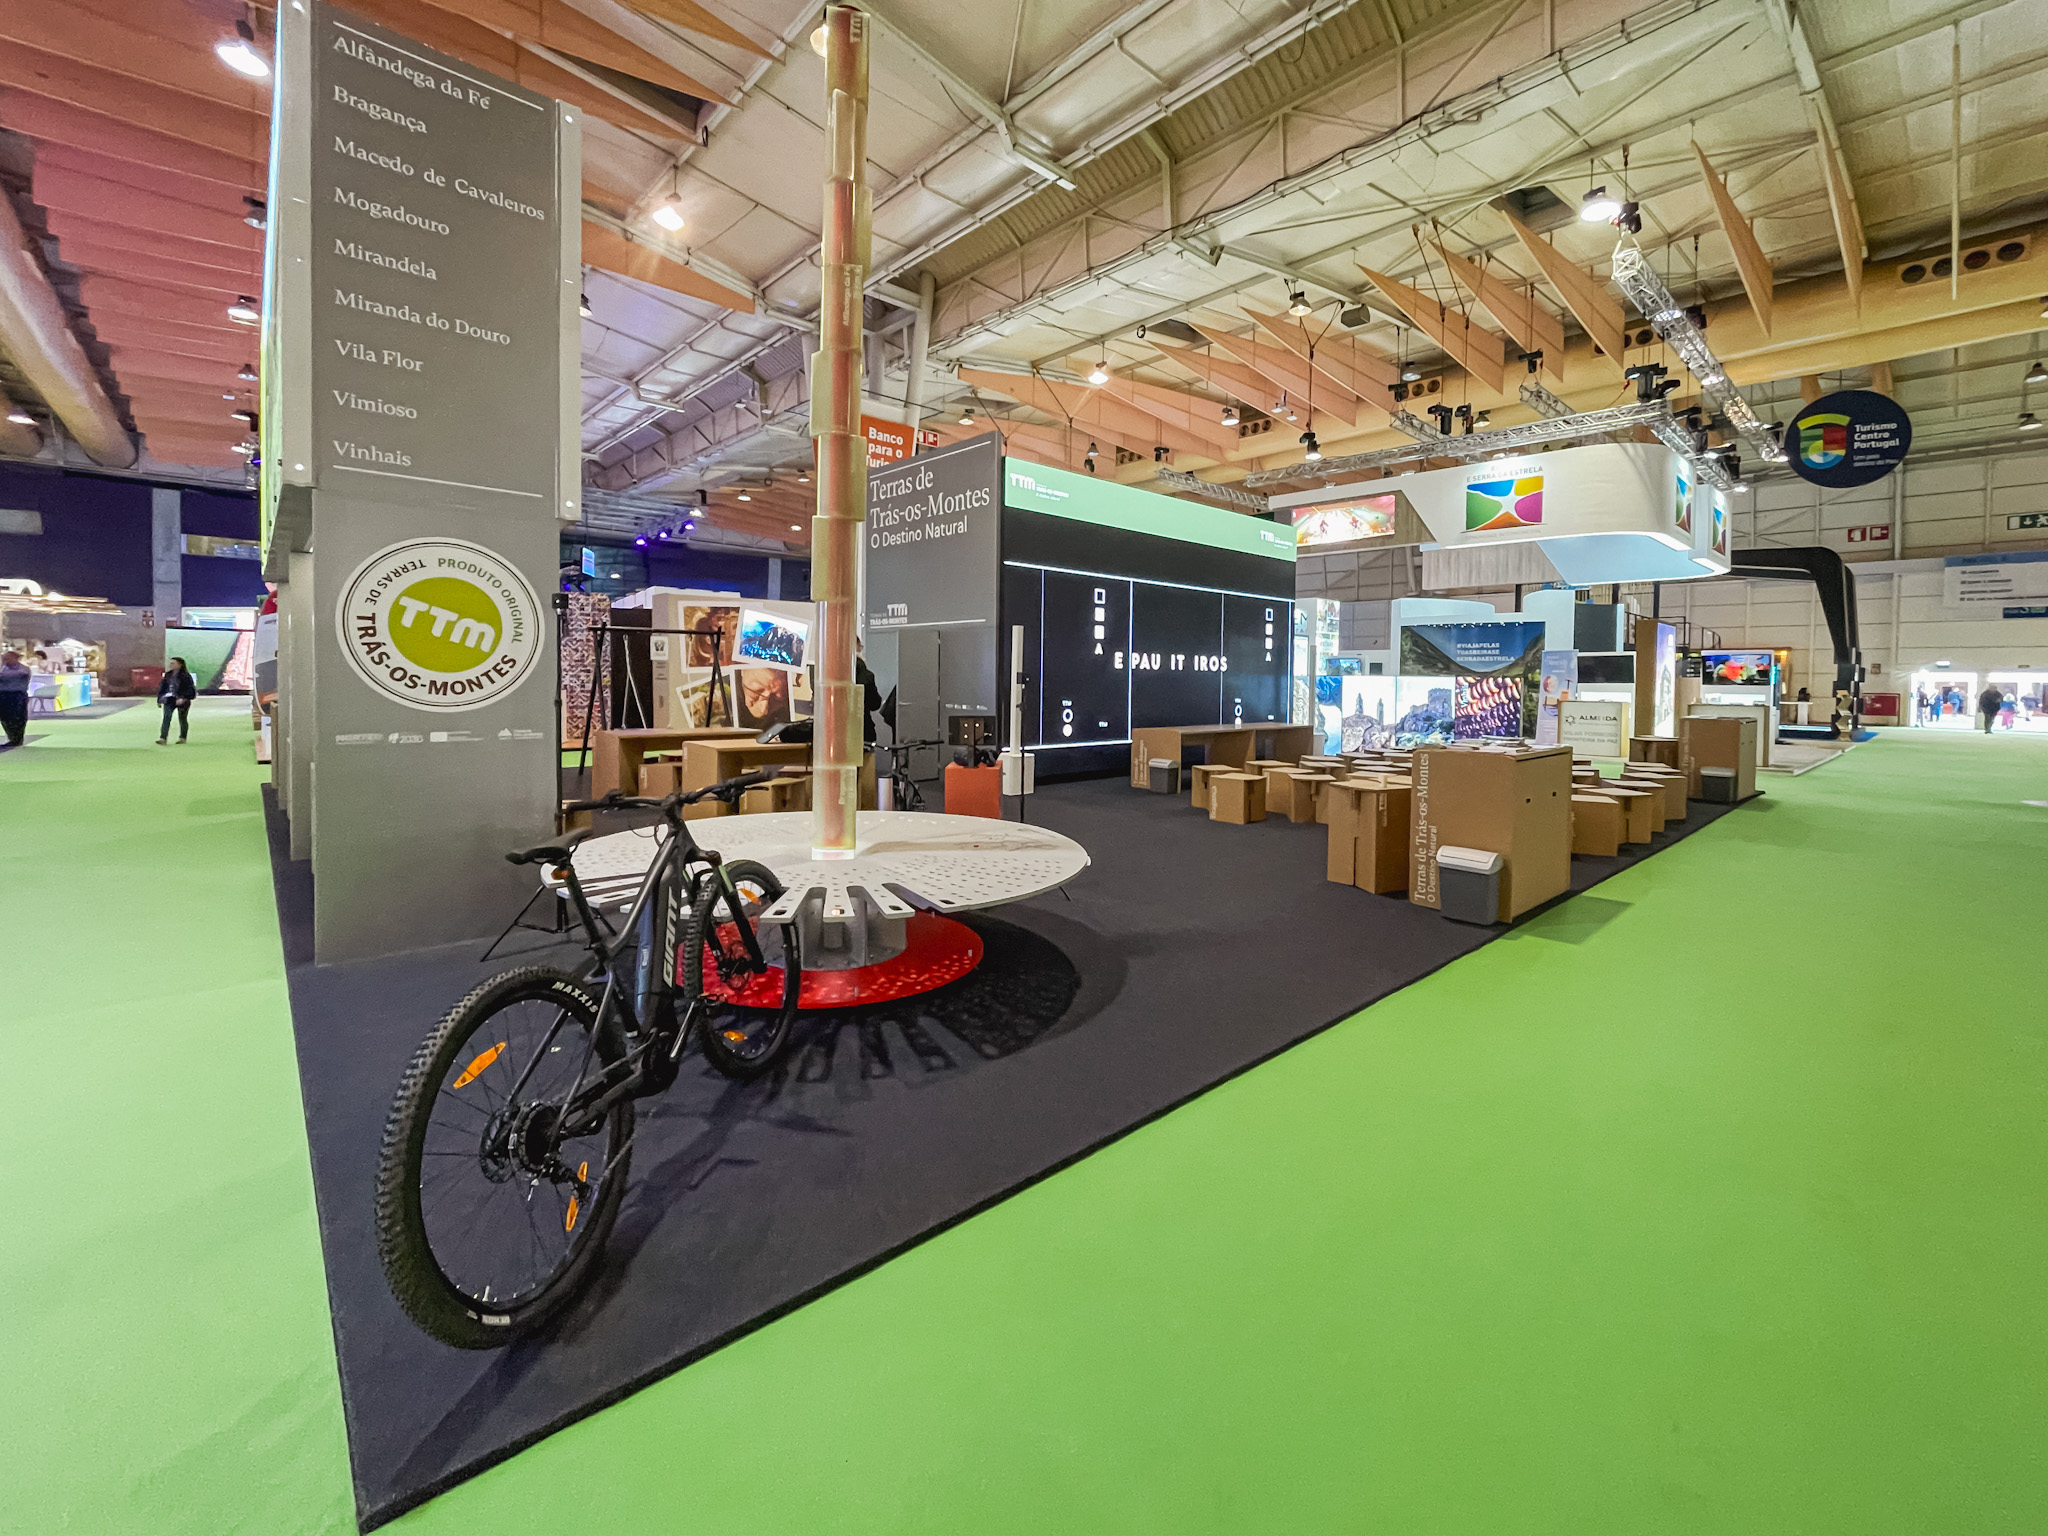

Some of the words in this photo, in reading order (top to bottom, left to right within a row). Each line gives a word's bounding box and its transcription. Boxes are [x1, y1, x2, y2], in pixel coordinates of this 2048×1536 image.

[332, 35, 436, 90] Alfândega
[440, 78, 463, 100] da
[468, 87, 490, 110] Fé
[333, 85, 427, 134] Bragança
[333, 136, 414, 176] Macedo
[424, 167, 446, 187] de
[454, 178, 545, 221] Cavaleiros
[333, 187, 450, 235] Mogadouro
[333, 238, 437, 280] Mirandela
[334, 289, 421, 325] Miranda
[426, 312, 449, 330] do
[454, 319, 511, 346] Douro
[334, 339, 377, 363] Vila
[382, 349, 424, 372] Flor
[332, 390, 417, 419] Vimioso
[868, 426, 903, 446] Banco
[1853, 438, 1899, 449] Portugal
[1854, 422, 1898, 432] Turismo
[1854, 432, 1890, 440] Centro
[332, 440, 412, 467] Vinhais
[868, 443, 893, 457] para
[895, 449, 903, 458] o
[870, 478, 913, 502] Terras
[916, 466, 934, 490] de
[1472, 474, 1496, 482] SERRA
[1510, 466, 1544, 476] ESTRELA
[870, 487, 991, 529] Trás-os-Montes
[870, 534, 881, 549] O
[882, 527, 923, 547] Destino
[925, 516, 968, 540] Natural
[376, 558, 427, 590] TERRAS
[365, 588, 382, 606] DE
[437, 557, 502, 589] PRODUTO
[501, 589, 524, 644] ORIGINAL
[356, 612, 518, 696] TRÁS-OS-MONTES
[1114, 651, 1124, 669] E
[1131, 652, 1161, 670] PAU
[1194, 654, 1228, 672] IROS
[1415, 753, 1429, 845] Trás-os-Montes
[1414, 848, 1427, 862] de
[1428, 825, 1437, 857] Natural
[1414, 864, 1427, 900] Terras
[1427, 859, 1436, 892] Destino
[1427, 894, 1436, 902] O
[663, 886, 678, 988] GIANT
[552, 981, 599, 1013] MAXXIS
